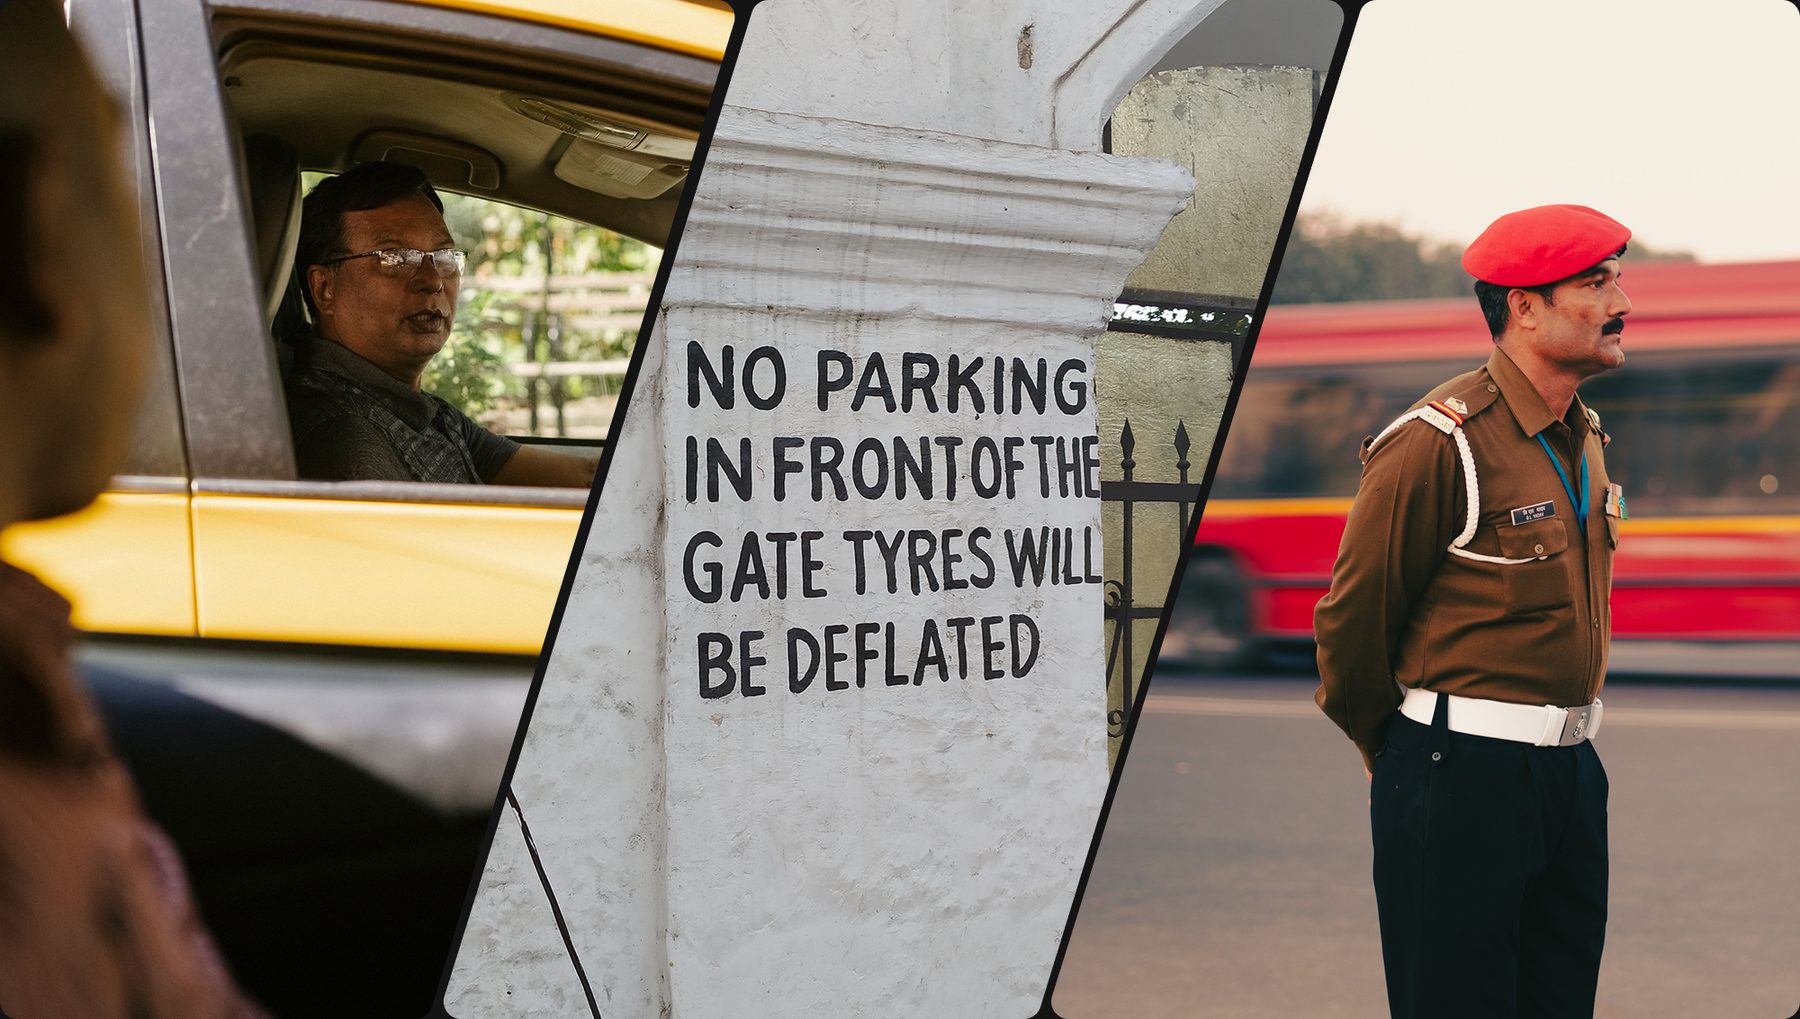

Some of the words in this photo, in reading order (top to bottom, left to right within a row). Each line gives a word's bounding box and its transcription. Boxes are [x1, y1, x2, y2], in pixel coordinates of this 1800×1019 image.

[686, 340, 787, 411] NO
[817, 350, 1087, 416] PARKING
[685, 435, 753, 503] IN
[772, 435, 964, 503] FRONT
[970, 435, 1025, 501] OF
[1030, 434, 1101, 499] THE
[682, 530, 828, 604] GATE
[842, 525, 997, 597] TYRES
[1003, 525, 1103, 589] WILL
[697, 630, 767, 700] BE
[786, 613, 1041, 695] DEFLATED
